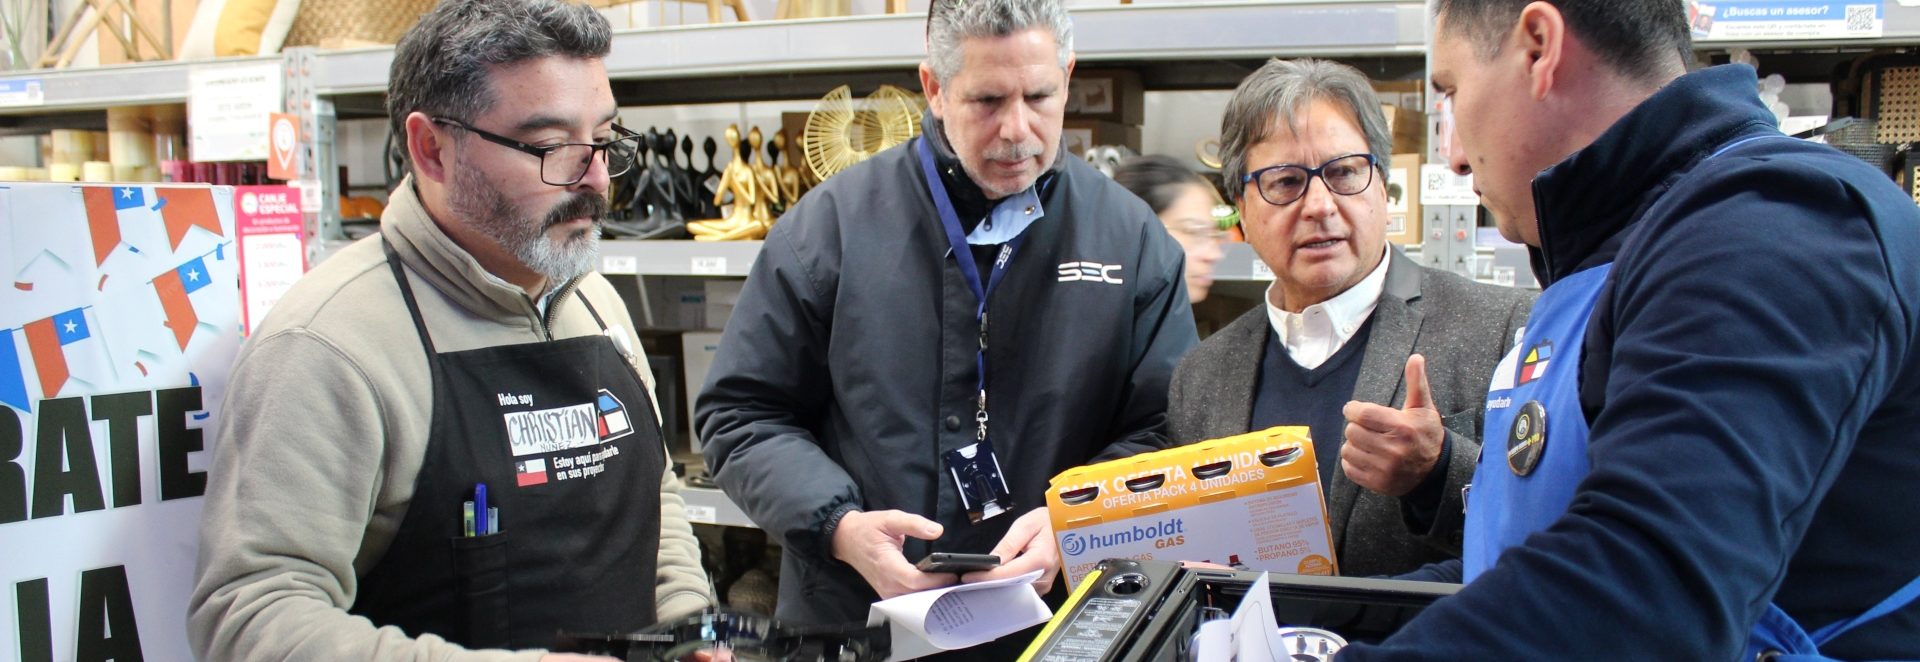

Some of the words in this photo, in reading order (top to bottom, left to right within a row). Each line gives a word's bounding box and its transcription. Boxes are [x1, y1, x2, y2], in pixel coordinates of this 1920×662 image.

[1722, 6, 1767, 18] ¿Buscas
[1786, 6, 1828, 15] asesor?
[258, 192, 287, 202] CANJE
[258, 203, 299, 215] ESPECIAL
[1058, 261, 1123, 284] SEC
[498, 393, 518, 407] Hola
[519, 394, 534, 407] soy
[553, 456, 575, 469] Estoy
[575, 451, 592, 466] aquí
[556, 471, 568, 480] en
[568, 468, 583, 479] sus
[1103, 490, 1153, 509] OFERTA
[1154, 485, 1187, 501] PACK
[1190, 482, 1197, 491] 4
[1200, 468, 1265, 490] UNIDADES
[1090, 518, 1183, 549] humboldt
[1155, 535, 1185, 549] GAS
[1258, 542, 1292, 554] BUTANO
[1259, 548, 1298, 561] PROPANO
